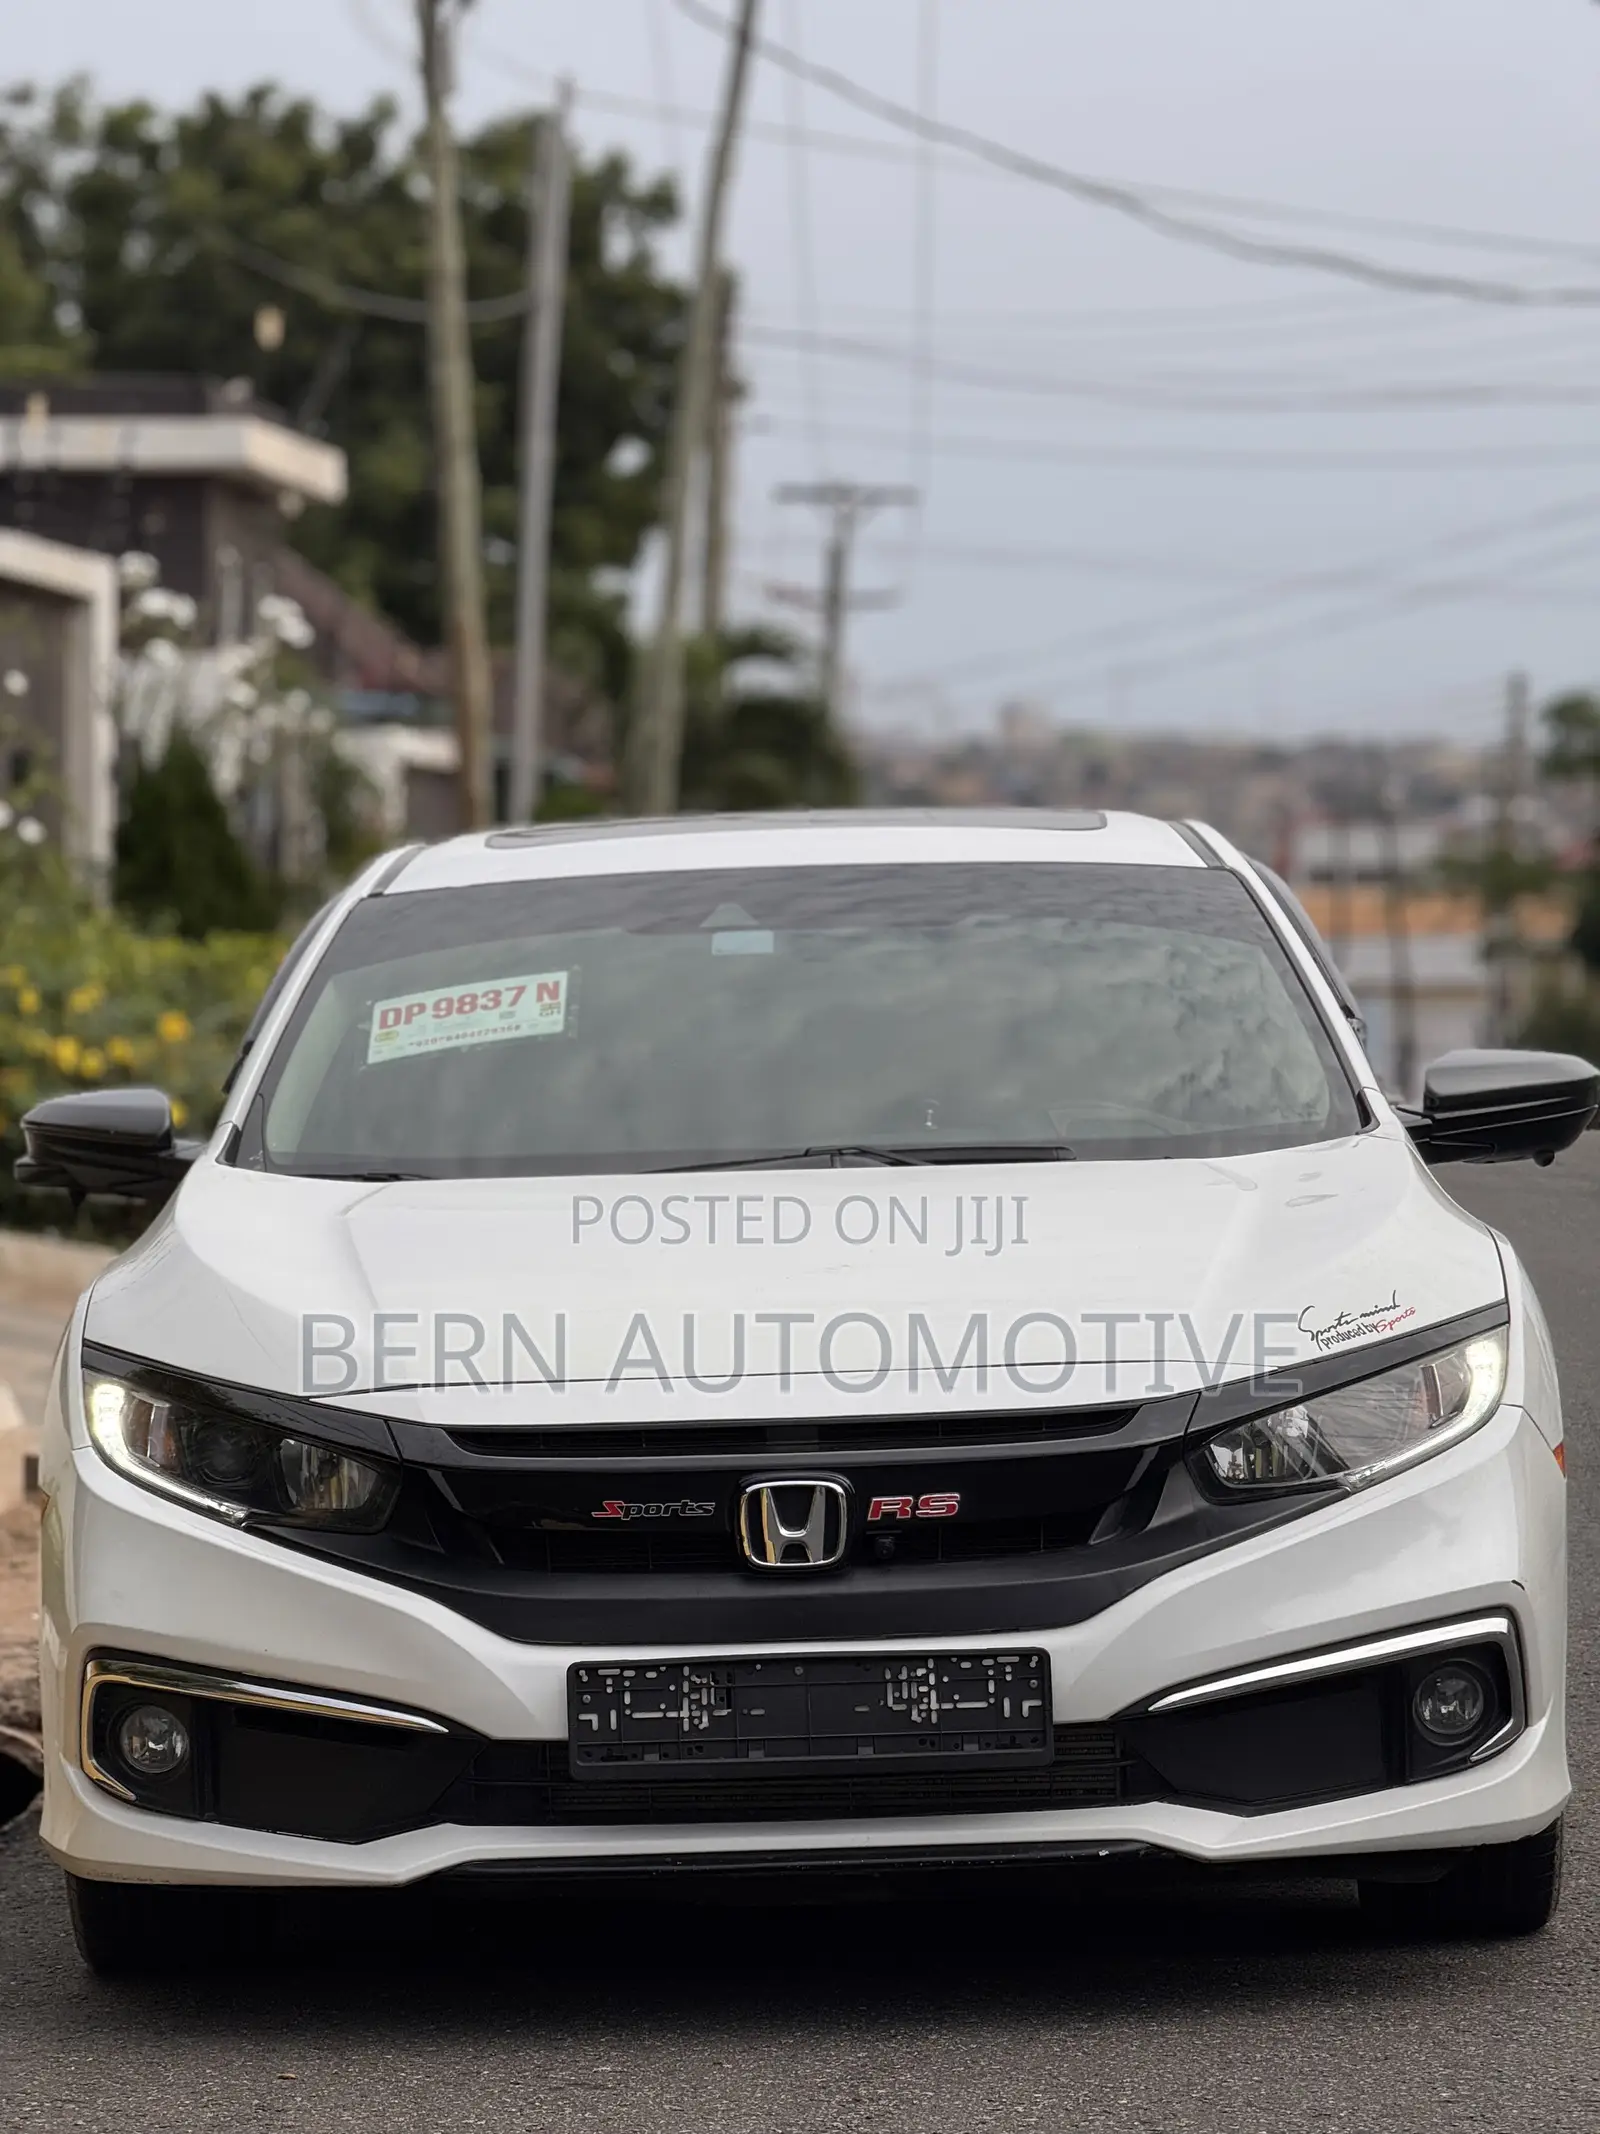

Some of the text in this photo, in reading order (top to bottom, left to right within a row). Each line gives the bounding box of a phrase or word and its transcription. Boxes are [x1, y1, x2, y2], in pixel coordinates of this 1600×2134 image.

[378, 980, 560, 1030] DP 9837 N
[1321, 1306, 1416, 1349] produced by Sports
[591, 1492, 961, 1522] Sports RS
